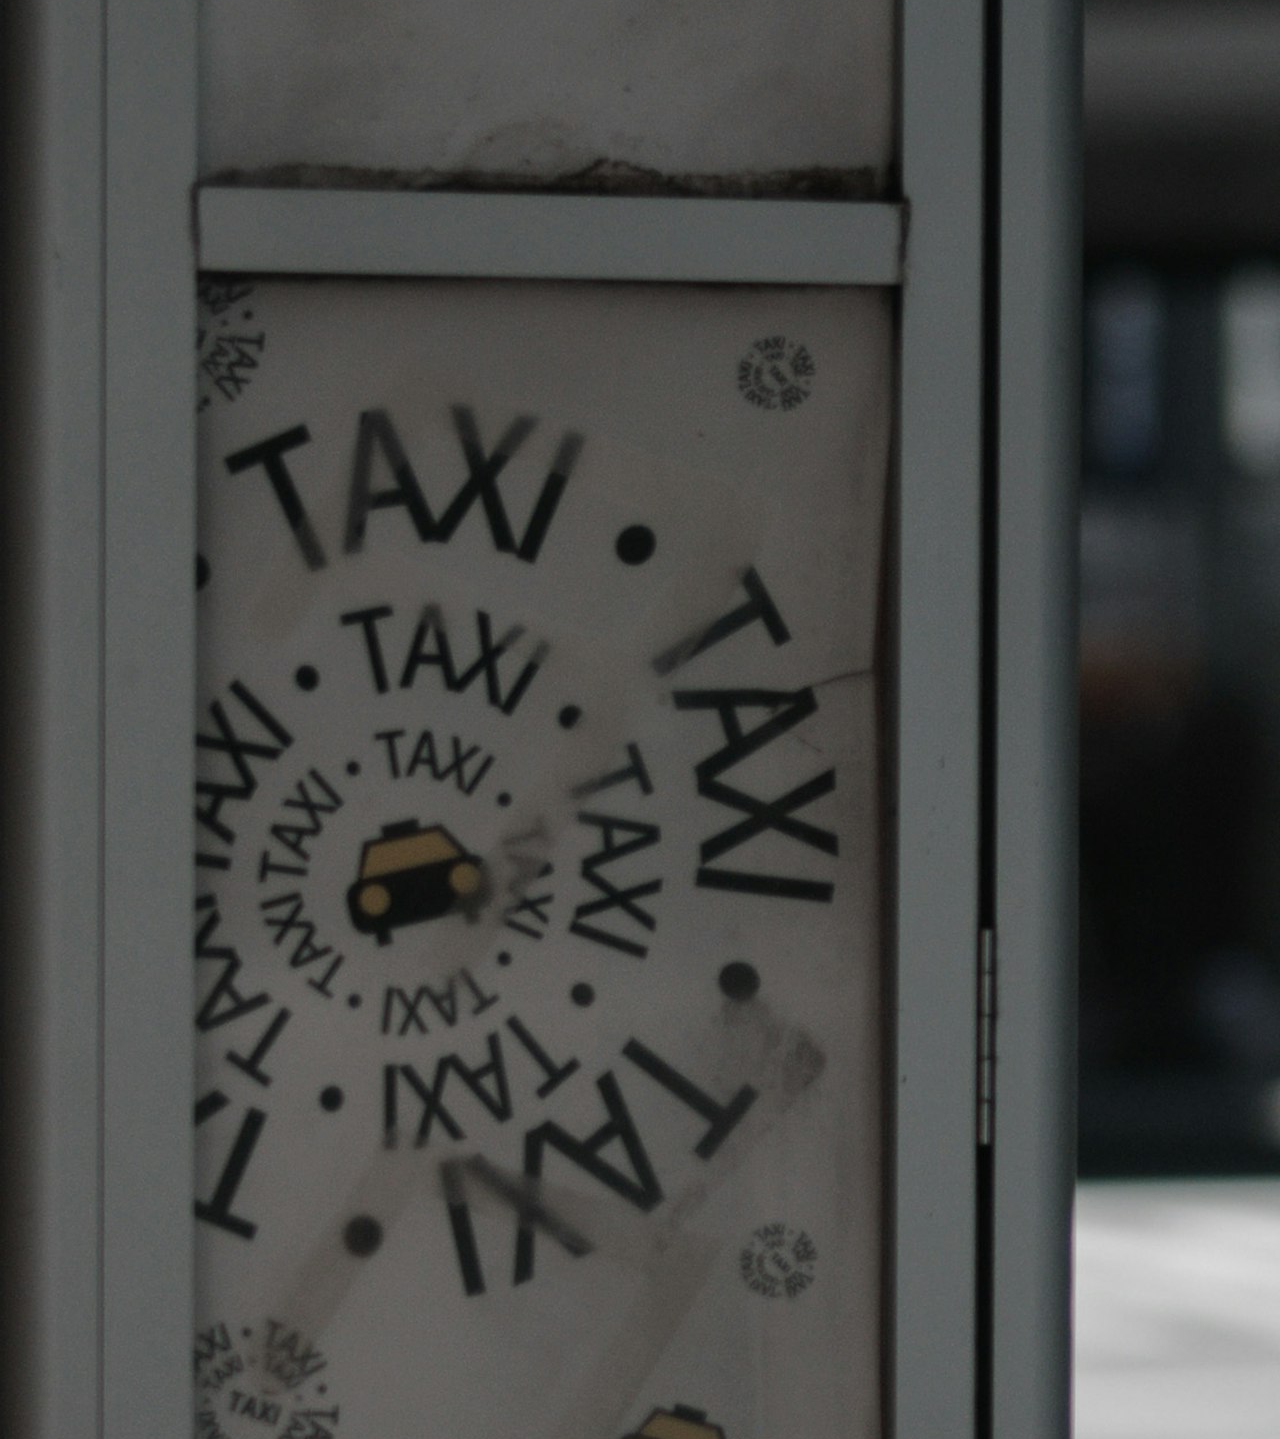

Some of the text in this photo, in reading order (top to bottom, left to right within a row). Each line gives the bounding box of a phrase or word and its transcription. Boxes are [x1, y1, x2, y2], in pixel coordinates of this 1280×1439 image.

[224, 405, 584, 572] TAXI
[340, 604, 550, 716] TAXI
[374, 729, 494, 795] TAXI
[651, 566, 839, 904] TAXI
[258, 768, 344, 882] TAXI
[568, 741, 663, 959] TAXI
[260, 892, 345, 999] TAXI
[381, 967, 500, 1036] TAXI
[381, 1014, 581, 1152] TAXI
[438, 1036, 759, 1297] TAXI
[230, 1390, 280, 1425] TAXI
